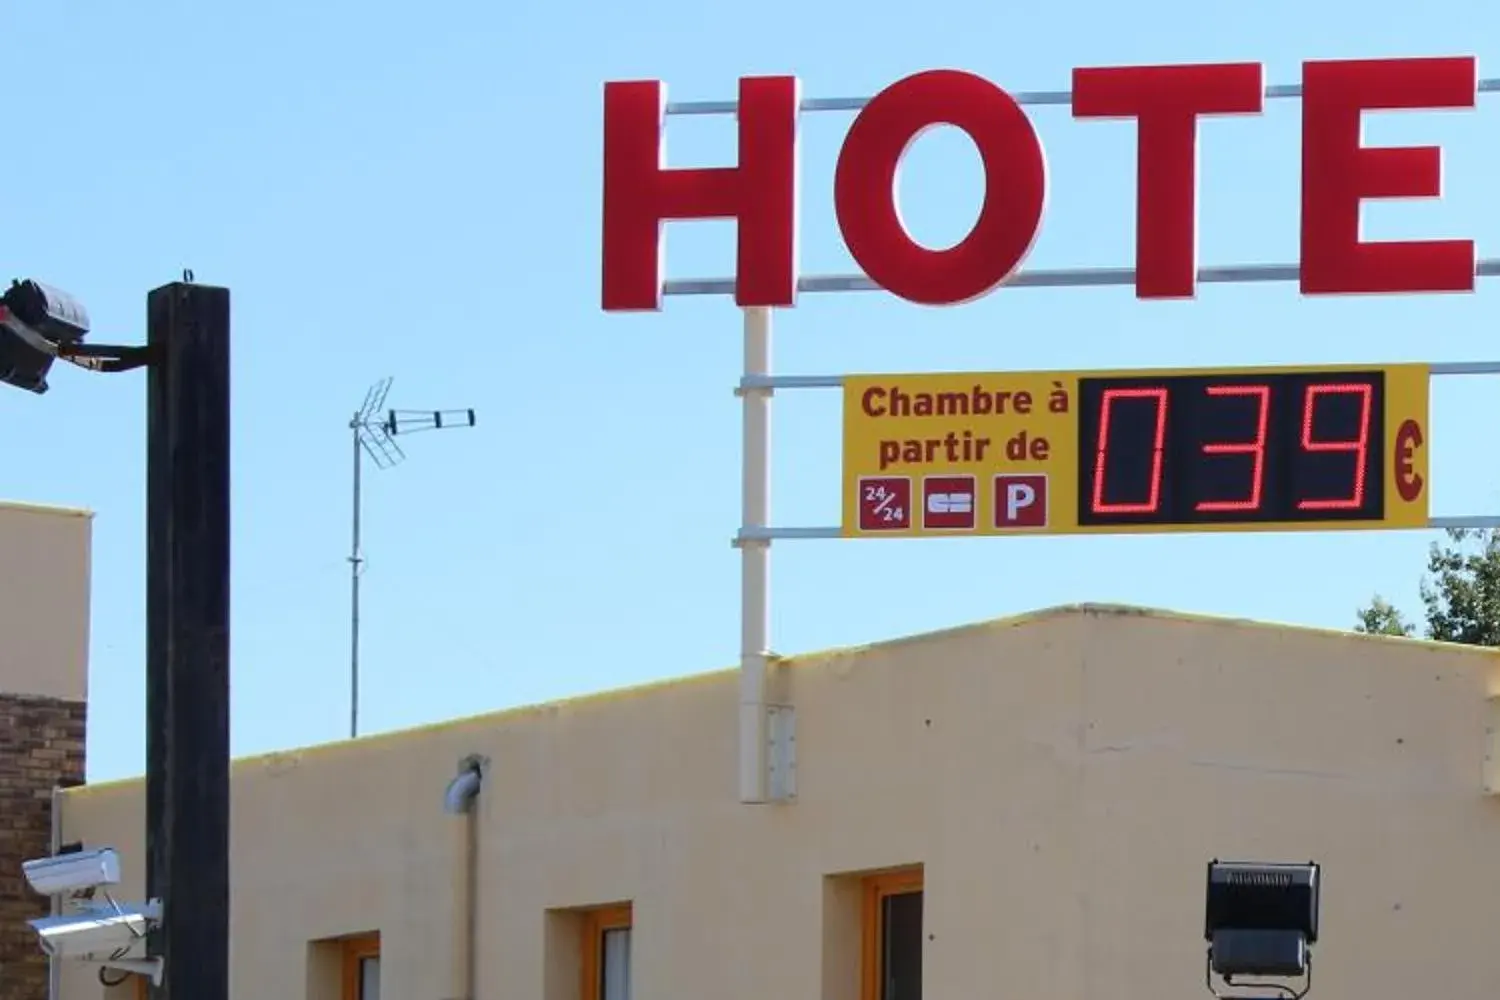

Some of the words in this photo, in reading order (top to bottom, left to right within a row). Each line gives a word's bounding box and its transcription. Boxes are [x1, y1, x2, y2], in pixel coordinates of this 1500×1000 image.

[861, 384, 1032, 417] Chambre
[1049, 381, 1069, 414] à
[879, 431, 990, 470] partir
[1006, 430, 1051, 462] de
[1092, 383, 1373, 512] 039
[1394, 419, 1424, 502] €
[864, 486, 904, 521] 24/24
[1007, 483, 1036, 520] P
